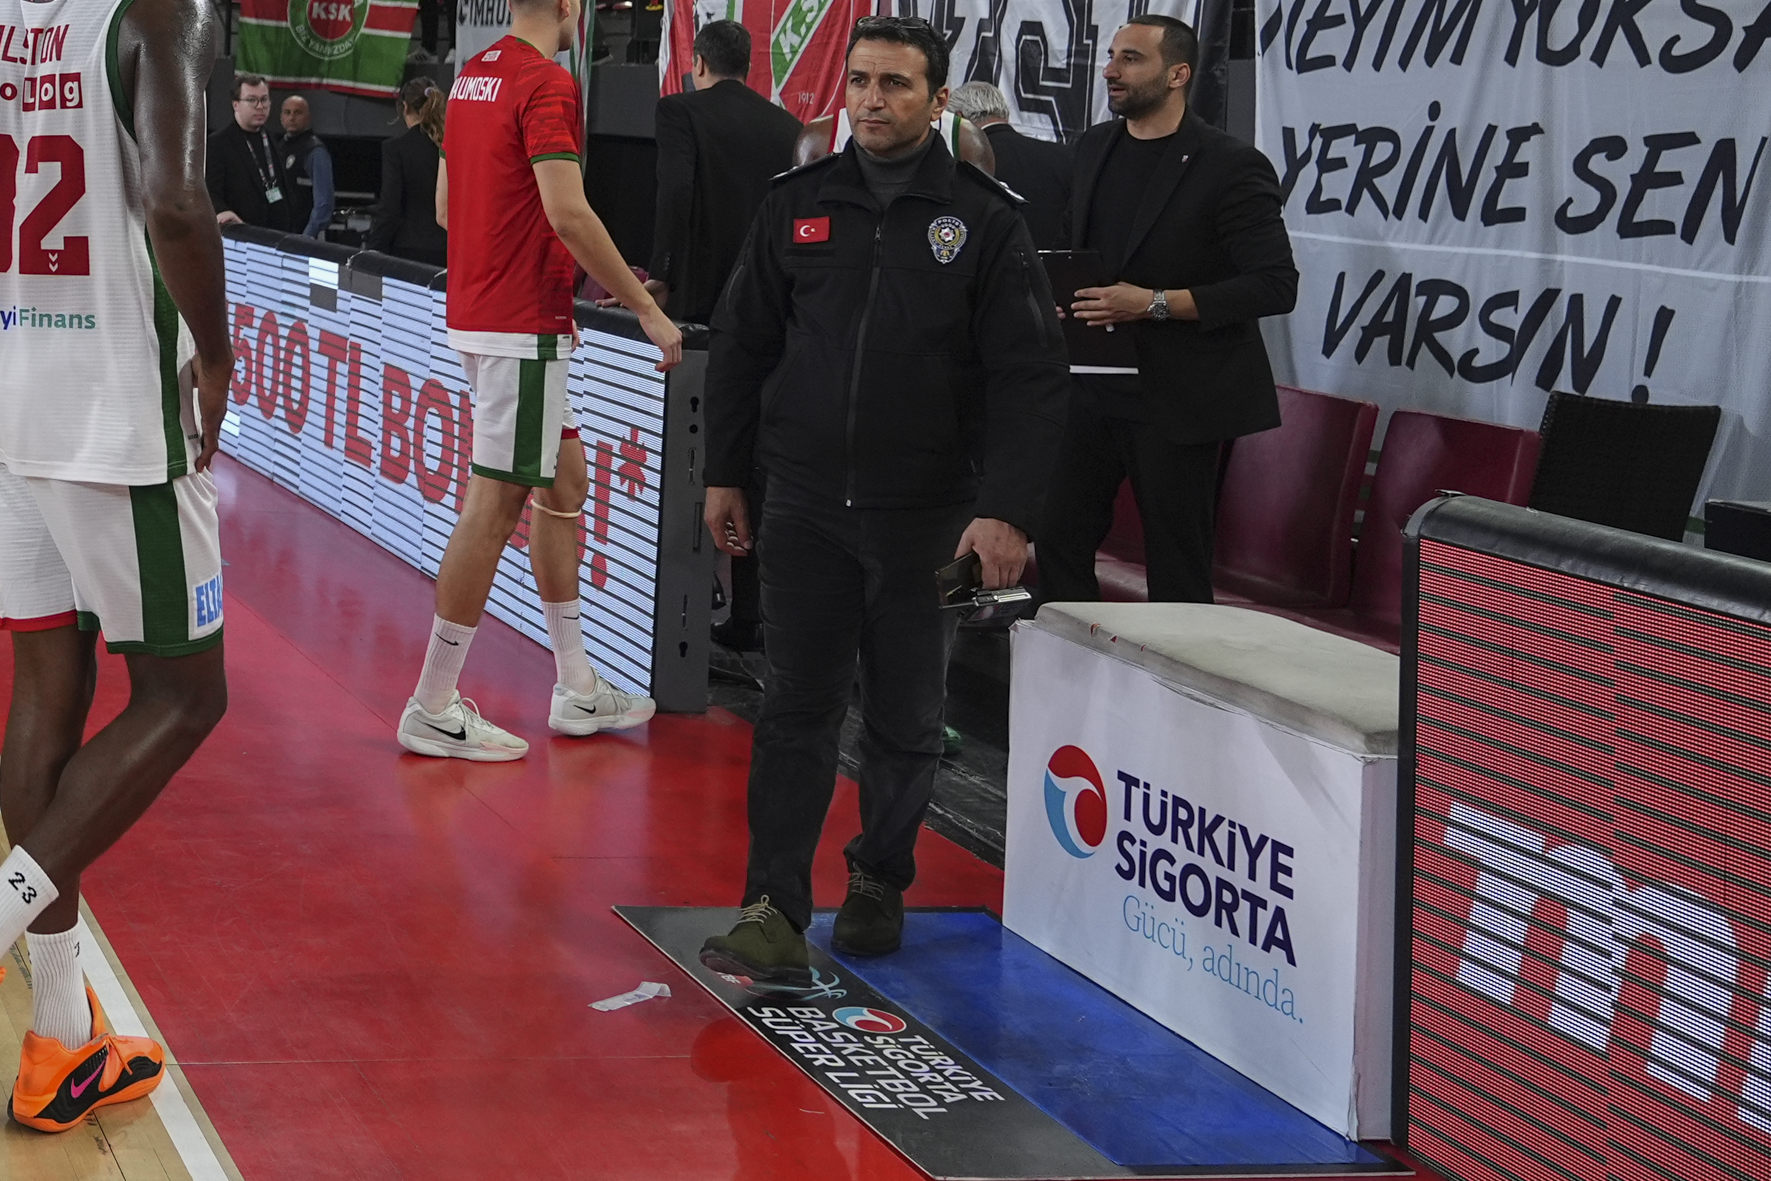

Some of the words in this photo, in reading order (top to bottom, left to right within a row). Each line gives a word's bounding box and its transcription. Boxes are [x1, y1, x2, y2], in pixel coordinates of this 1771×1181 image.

[312, 2, 352, 22] KSK
[798, 91, 815, 105] 1912
[1281, 100, 1545, 228] YERİNE
[1554, 130, 1768, 246] SEN
[1321, 269, 1623, 395] VARSIN
[318, 329, 372, 469] TL
[8, 871, 38, 905] 23
[1117, 769, 1295, 901] TÜRKİYE
[1114, 829, 1298, 969] SİGORTA
[1122, 894, 1195, 973] Gücü,
[1201, 943, 1304, 1025] adında.
[747, 1006, 847, 1069] SÜPER
[825, 1071, 904, 1110] LİGİ
[786, 1006, 949, 1121] BASKETBOL
[863, 1035, 969, 1104] SİGORTA
[898, 1034, 1006, 1103] TÜRKİYE
